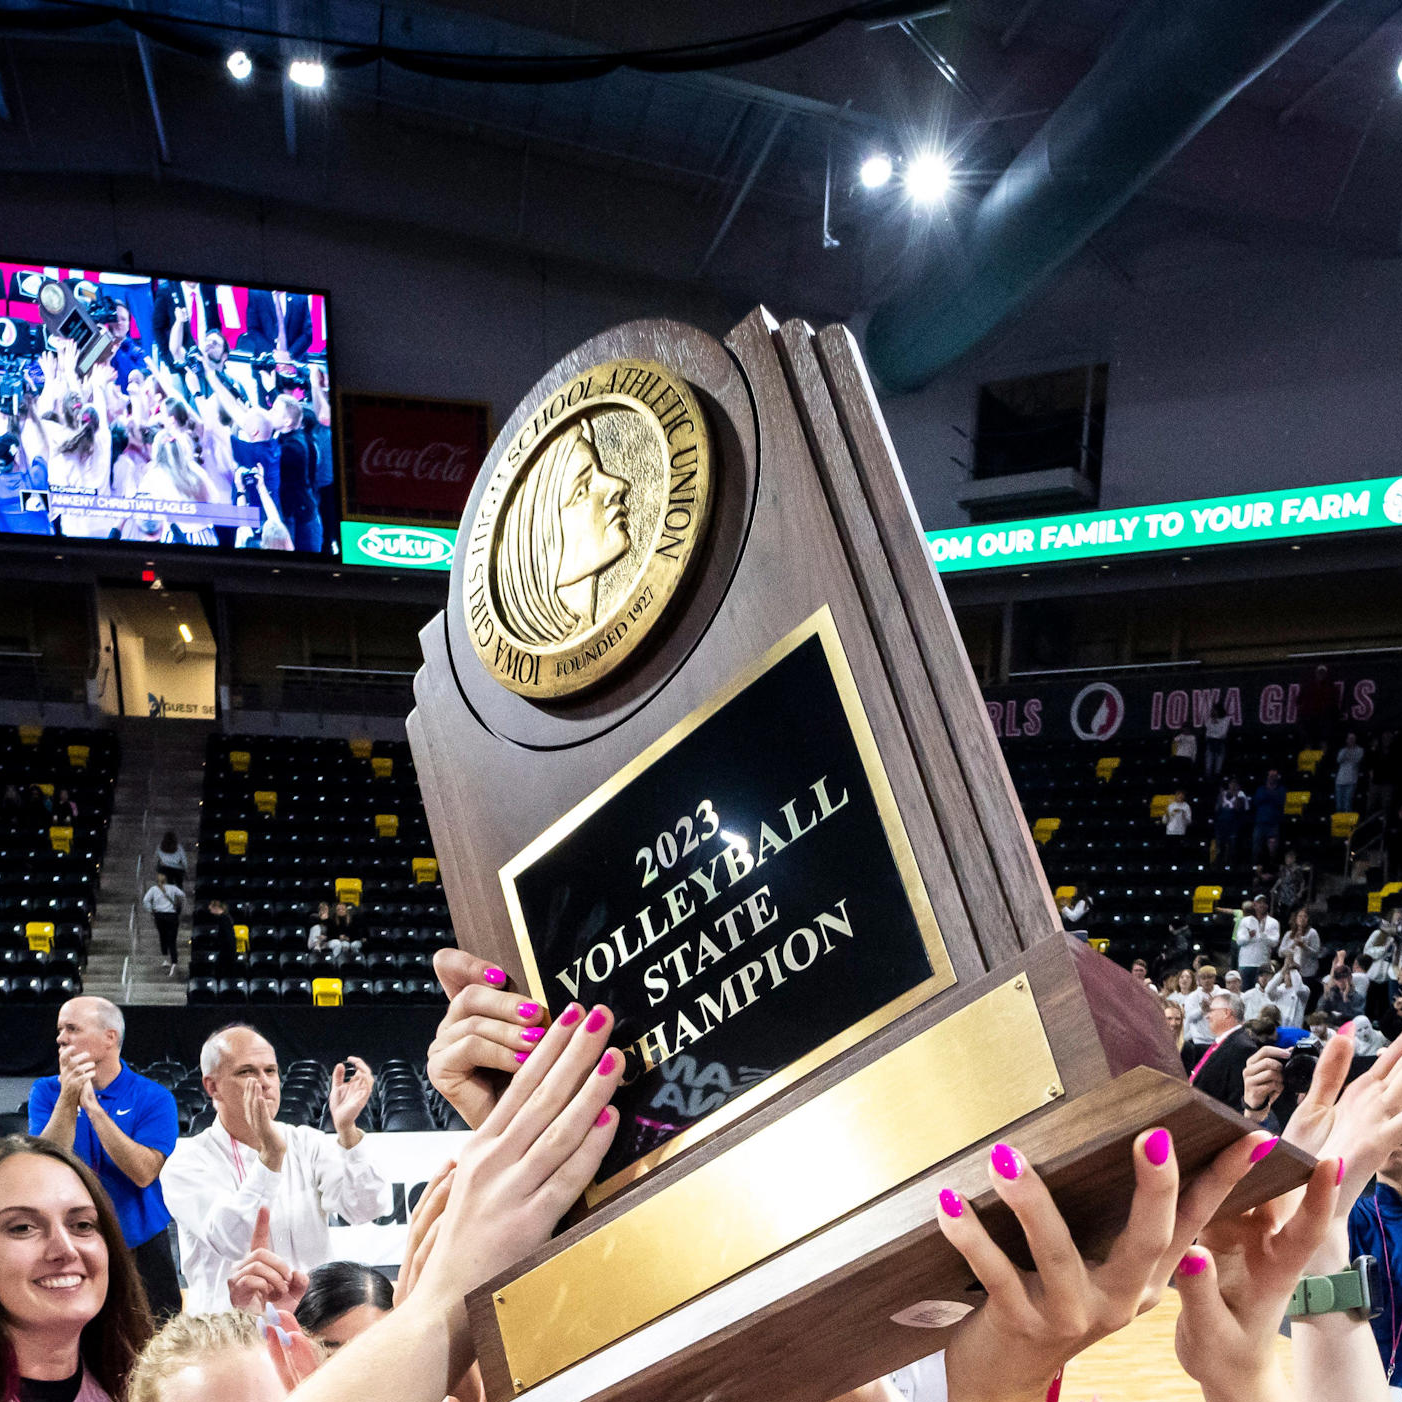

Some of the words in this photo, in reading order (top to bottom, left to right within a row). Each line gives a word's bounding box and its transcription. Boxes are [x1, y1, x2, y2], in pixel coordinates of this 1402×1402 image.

[507, 376, 594, 470] SCHOOL
[601, 367, 697, 441] ATHLETIC
[367, 527, 445, 560] Sukup
[654, 443, 700, 562] UNION
[929, 534, 971, 562] OM
[978, 527, 1034, 559] OUR
[1040, 517, 1141, 553] FAMILY
[1148, 510, 1185, 538] TO
[1191, 503, 1273, 534] YOUR
[1281, 491, 1371, 525] FARM
[467, 562, 496, 648] GIRLS
[554, 620, 629, 679] FOUNDED
[626, 585, 656, 624] 1927
[493, 638, 543, 686] IOWA
[554, 775, 850, 1001] VOLLEYBALL
[635, 799, 721, 889] 2023
[642, 885, 780, 1008] STATE
